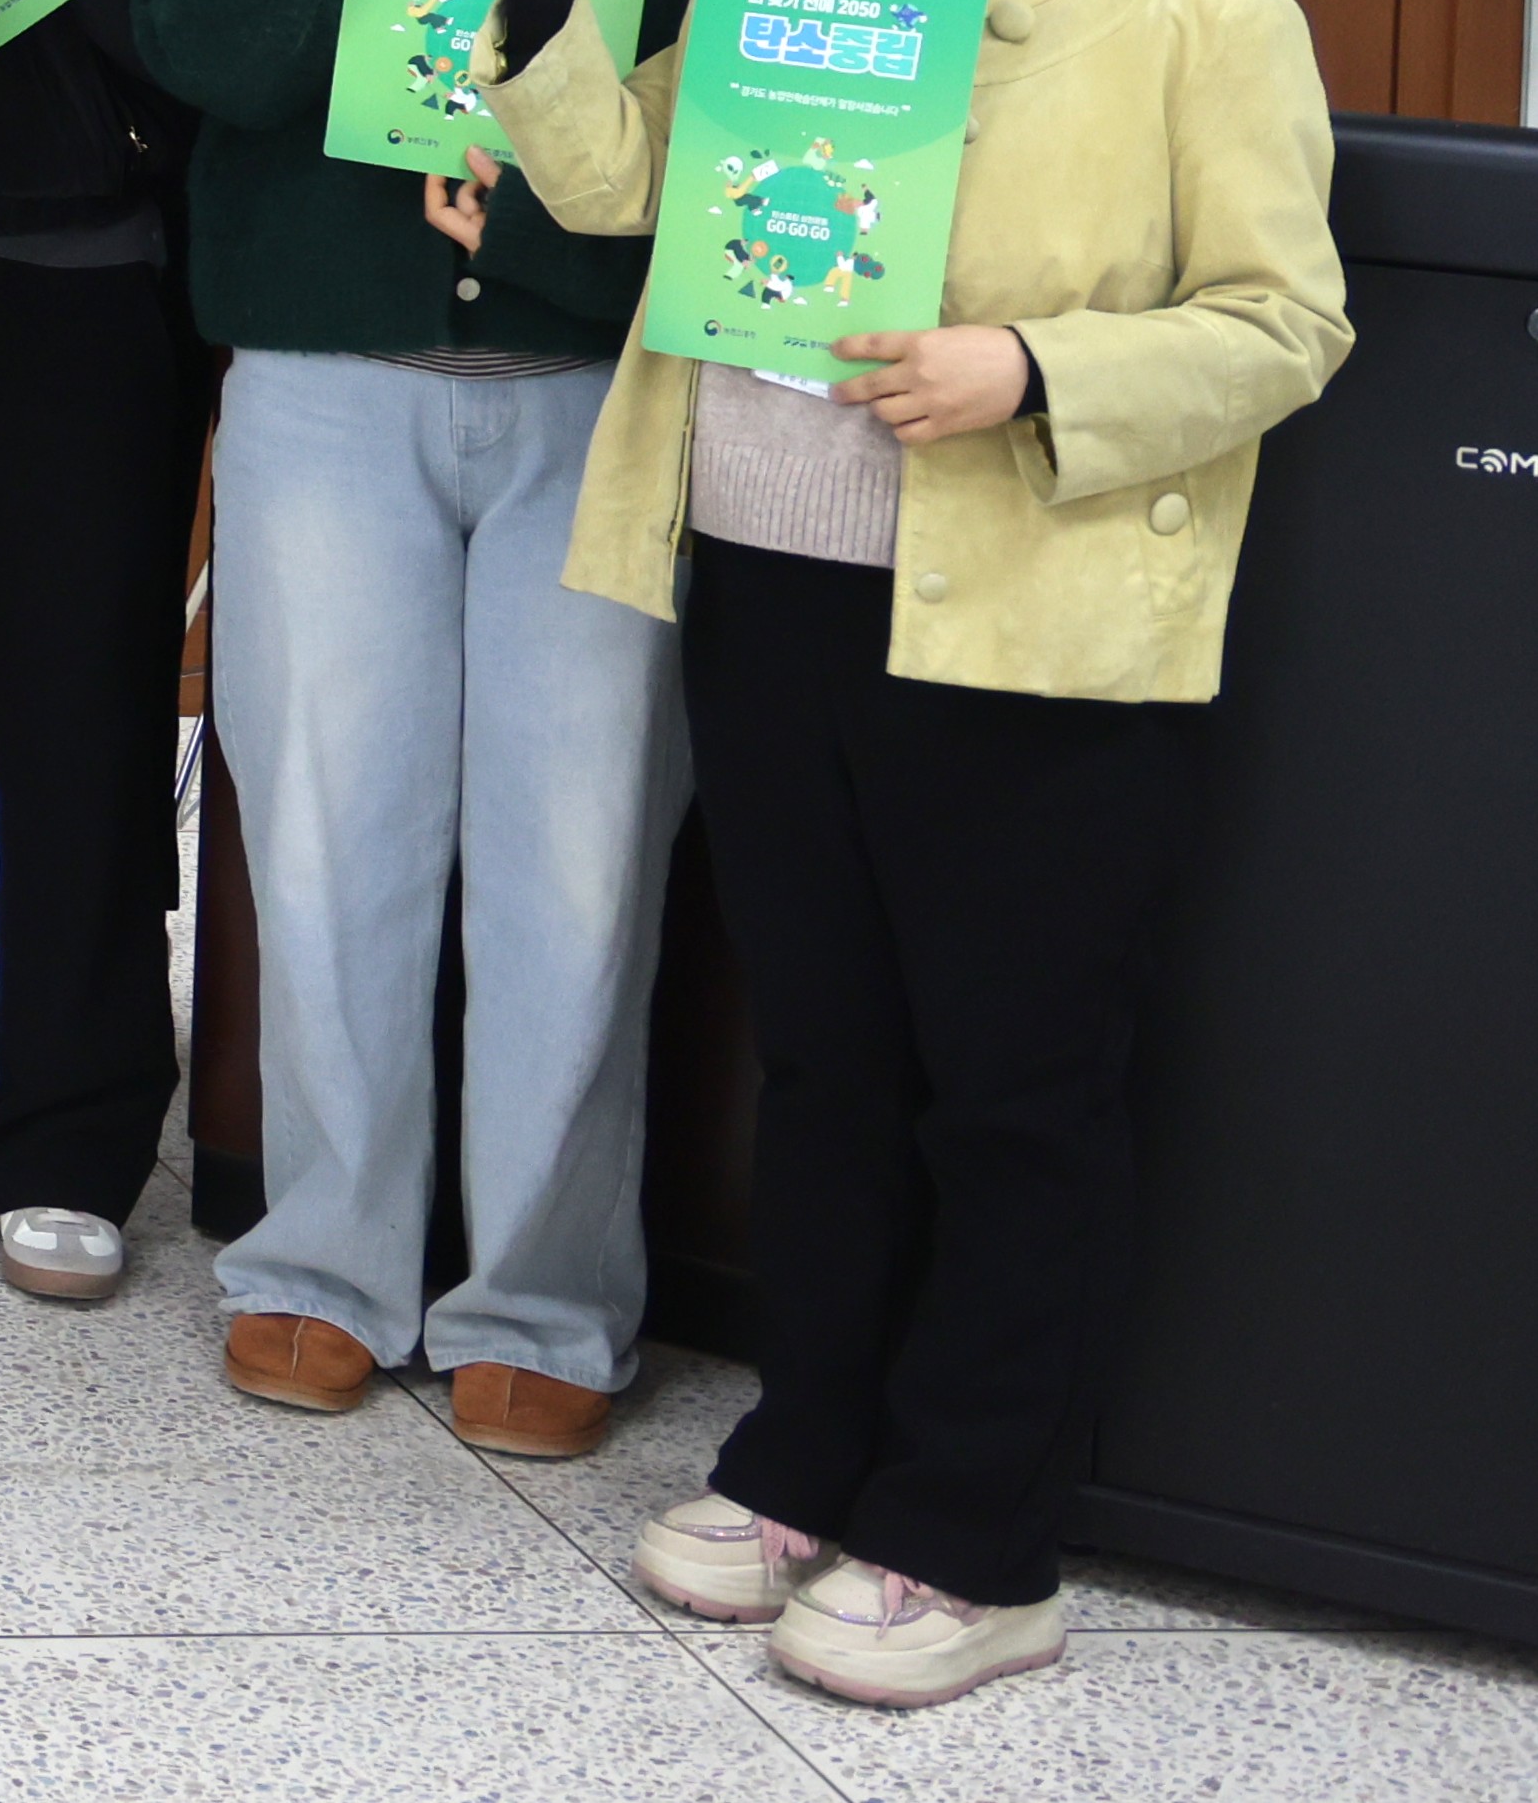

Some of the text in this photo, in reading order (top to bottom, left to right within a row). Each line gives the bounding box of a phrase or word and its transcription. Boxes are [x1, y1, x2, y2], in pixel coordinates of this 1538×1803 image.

[450, 36, 471, 51] GO
[739, 11, 922, 80] 탄소중립
[765, 218, 786, 234] GO
[786, 221, 808, 237] GO
[808, 224, 830, 240] GO
